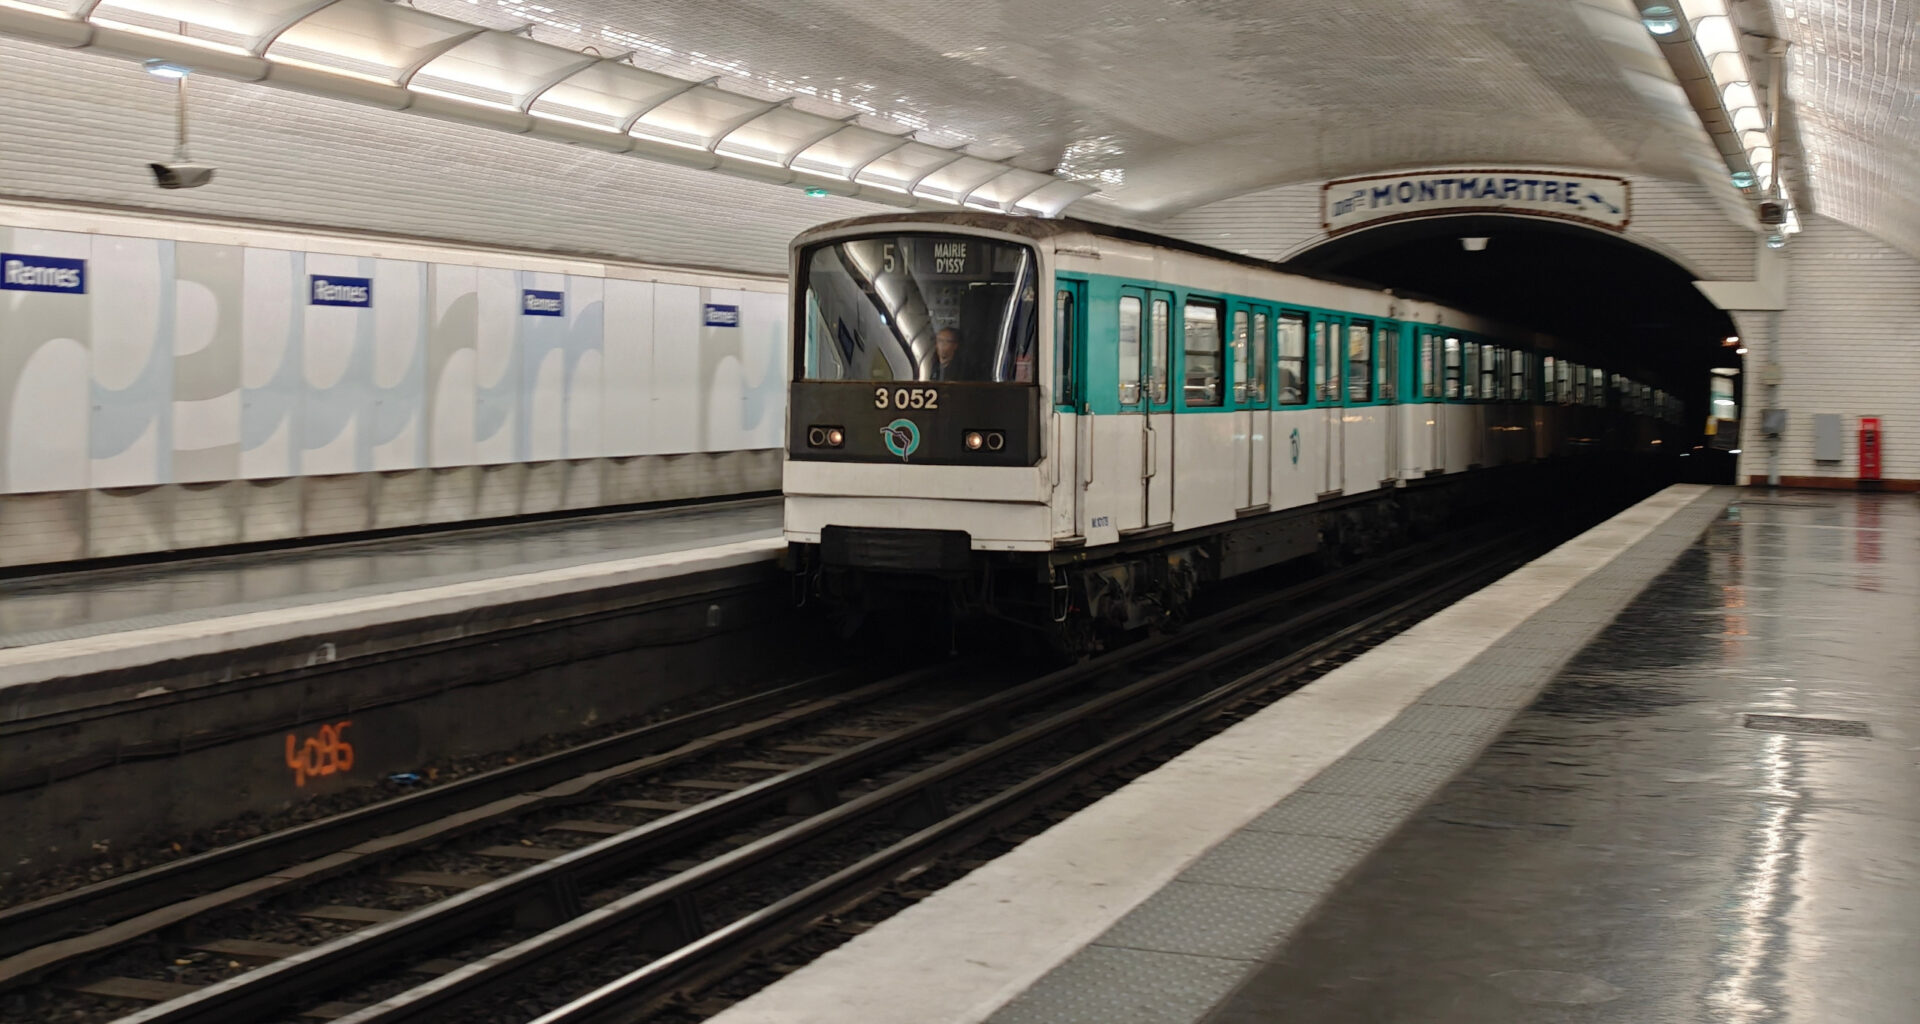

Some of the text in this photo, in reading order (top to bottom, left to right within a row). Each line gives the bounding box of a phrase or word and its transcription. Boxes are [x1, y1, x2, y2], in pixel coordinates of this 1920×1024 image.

[1370, 177, 1582, 208] MONTMARTRE
[934, 243, 967, 258] MAIRIE
[5, 259, 81, 288] Rennes
[936, 258, 965, 273] D'ISSY
[313, 279, 368, 303] Rennes
